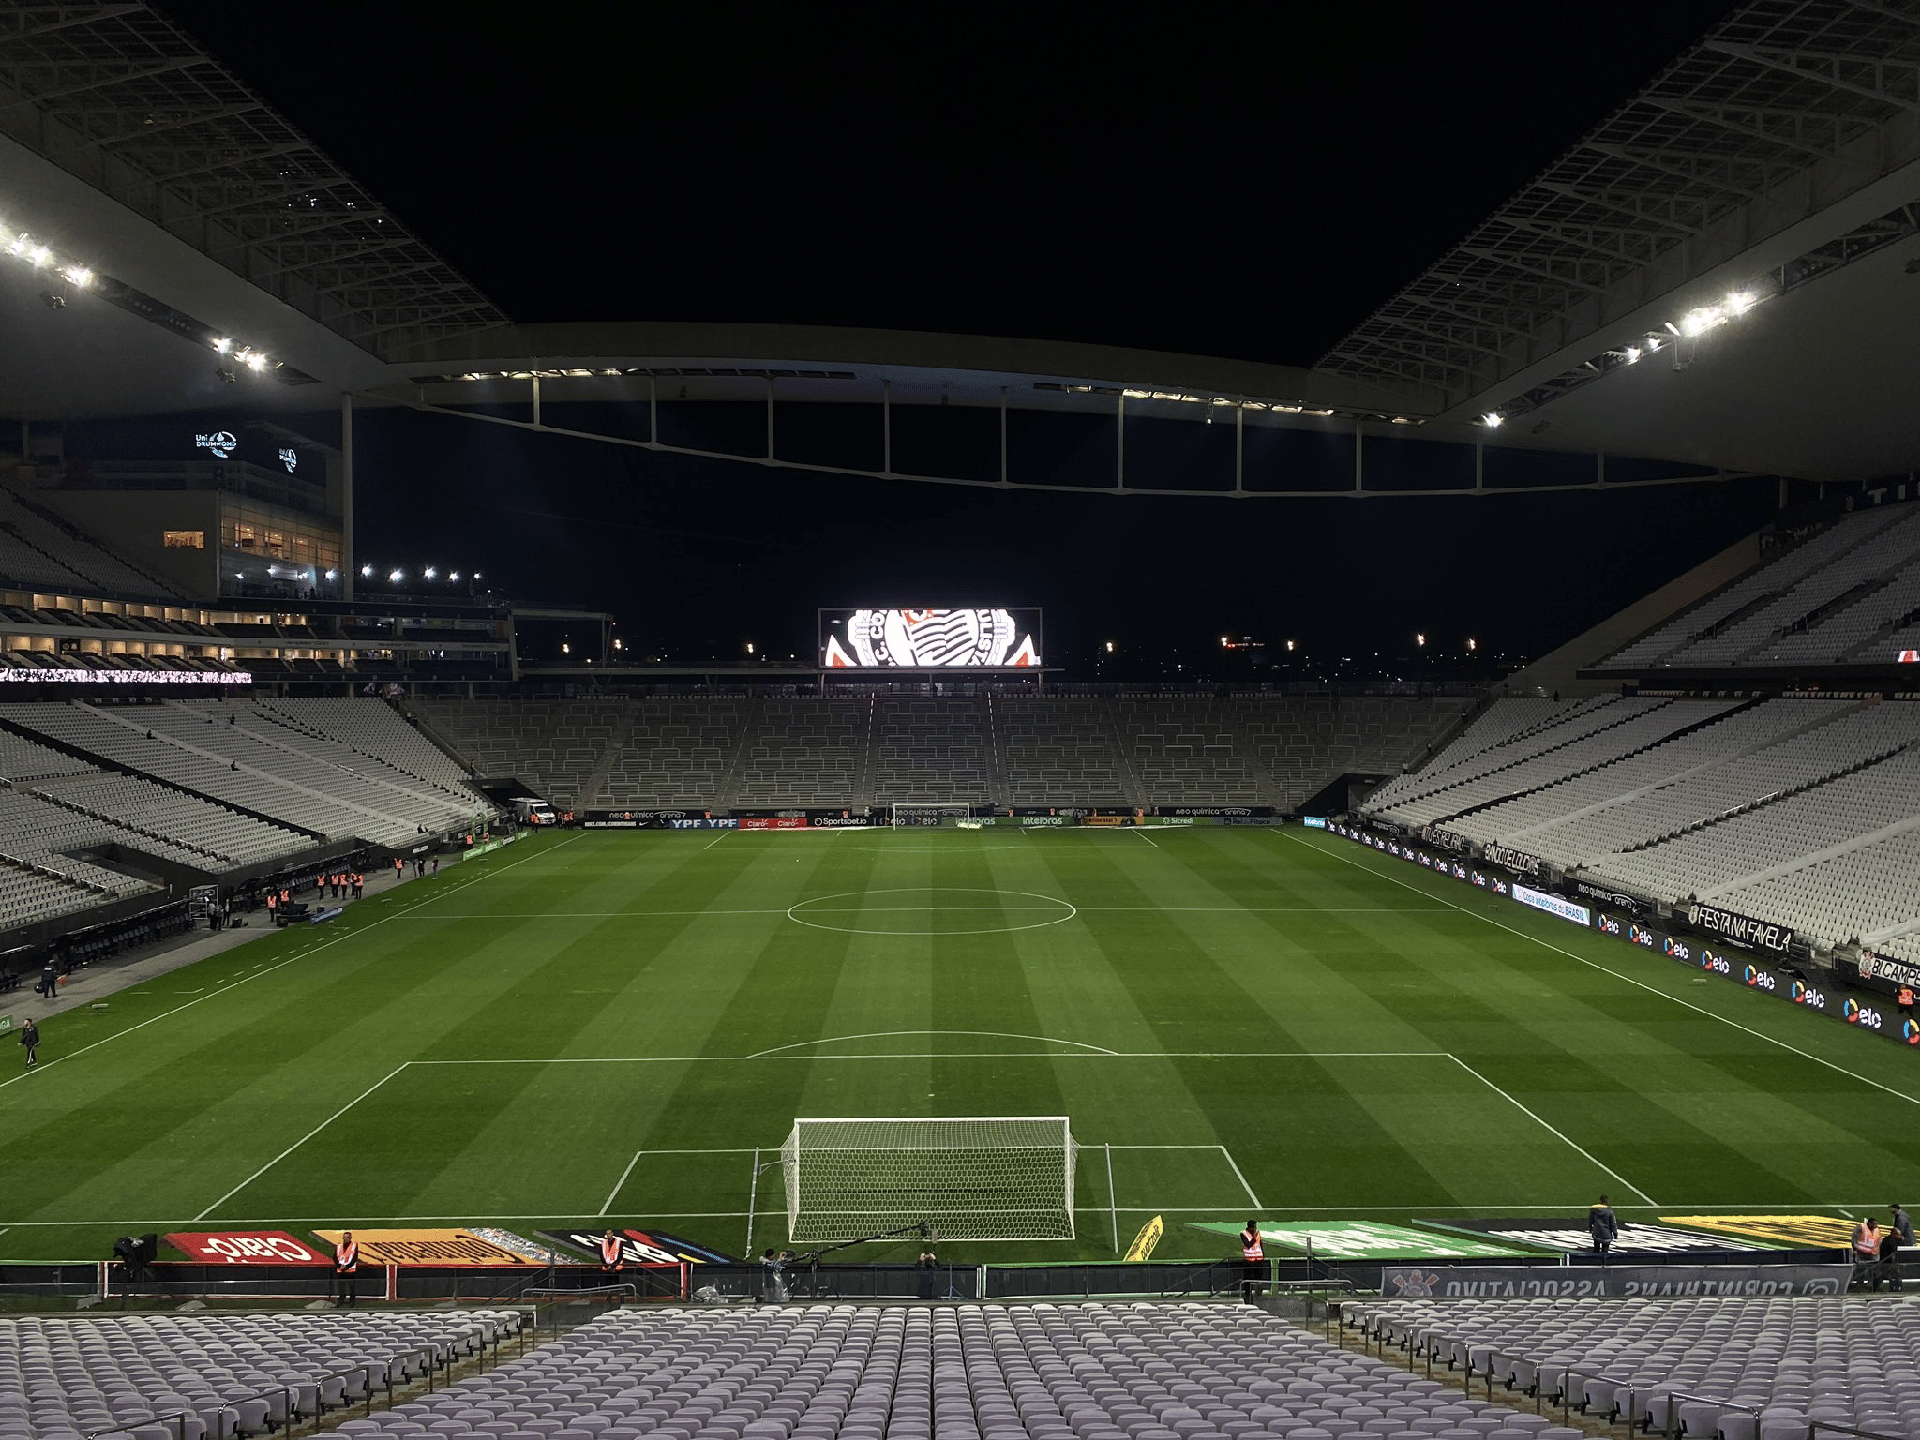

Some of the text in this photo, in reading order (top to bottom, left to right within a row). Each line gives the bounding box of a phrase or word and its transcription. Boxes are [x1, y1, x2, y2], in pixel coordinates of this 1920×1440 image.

[672, 819, 701, 828] YPF
[708, 818, 737, 828] YPF
[822, 817, 867, 826] Sportsbet.io
[1606, 920, 1619, 935] elo
[1638, 930, 1653, 946] elo
[1673, 943, 1689, 960] elo
[1712, 956, 1730, 974] elo
[1756, 971, 1776, 990] elo
[1805, 988, 1825, 1009] elo
[1859, 1008, 1882, 1029] elo
